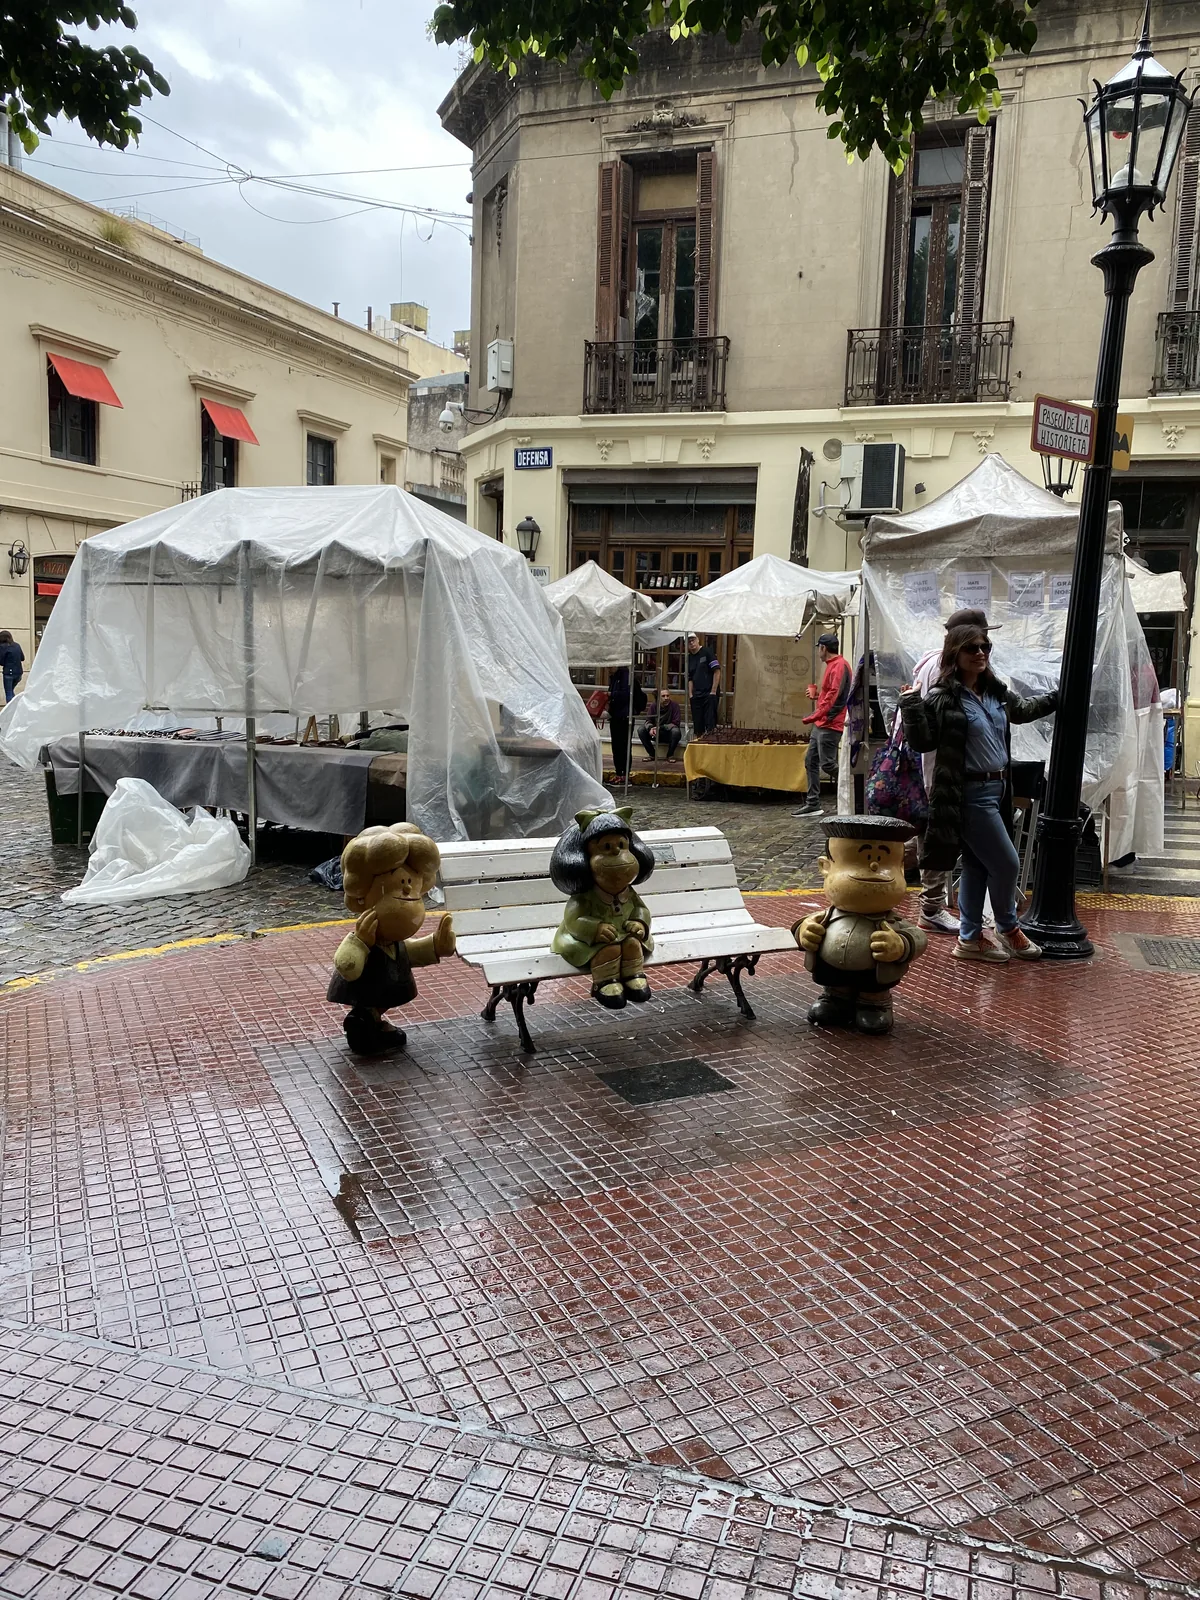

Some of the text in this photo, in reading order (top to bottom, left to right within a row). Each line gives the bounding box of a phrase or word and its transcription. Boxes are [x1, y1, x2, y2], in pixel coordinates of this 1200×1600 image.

[1042, 408, 1089, 434] PASEO DE LA
[1040, 430, 1087, 454] HISTORIETA
[517, 450, 549, 466] DEFENSA
